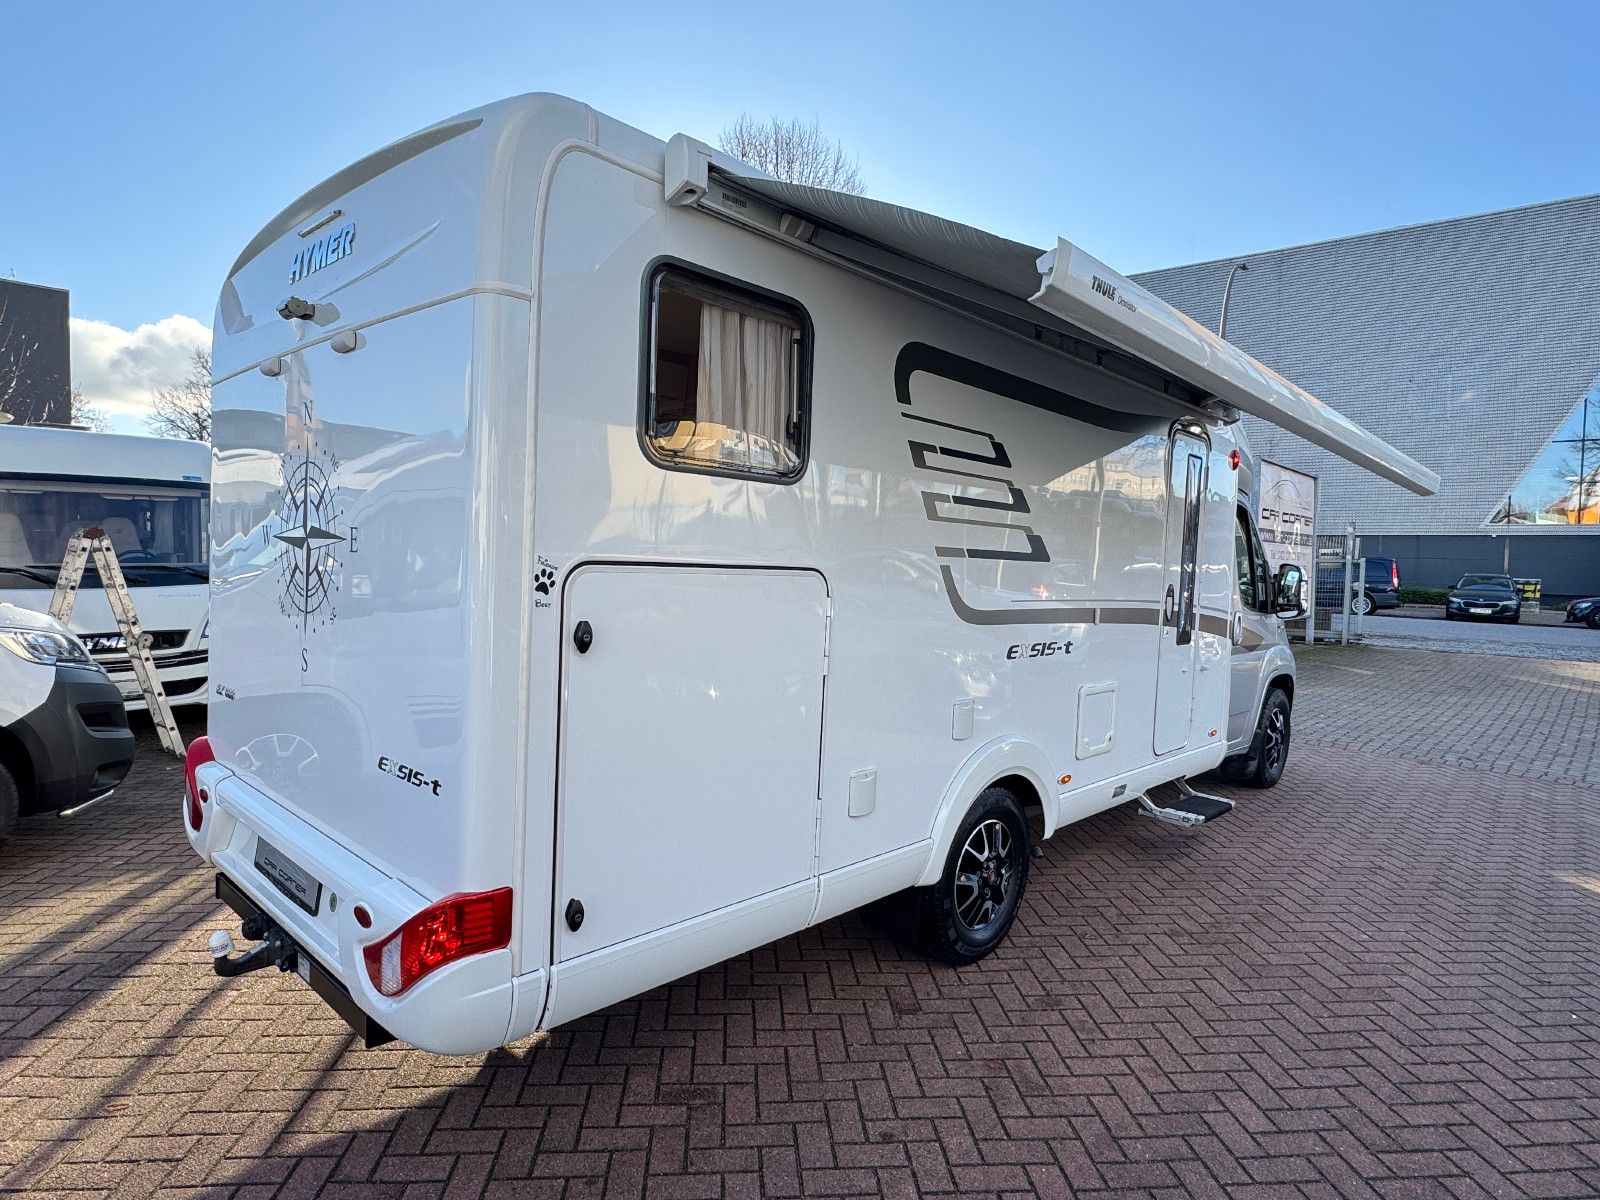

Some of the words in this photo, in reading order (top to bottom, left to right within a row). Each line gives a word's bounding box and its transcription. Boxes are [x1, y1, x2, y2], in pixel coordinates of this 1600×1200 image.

[288, 222, 356, 286] HYMER
[1091, 274, 1116, 301] THULE
[349, 526, 360, 553] E
[1006, 640, 1074, 660] EXSIS-t
[377, 756, 442, 797] EXSIS-t
